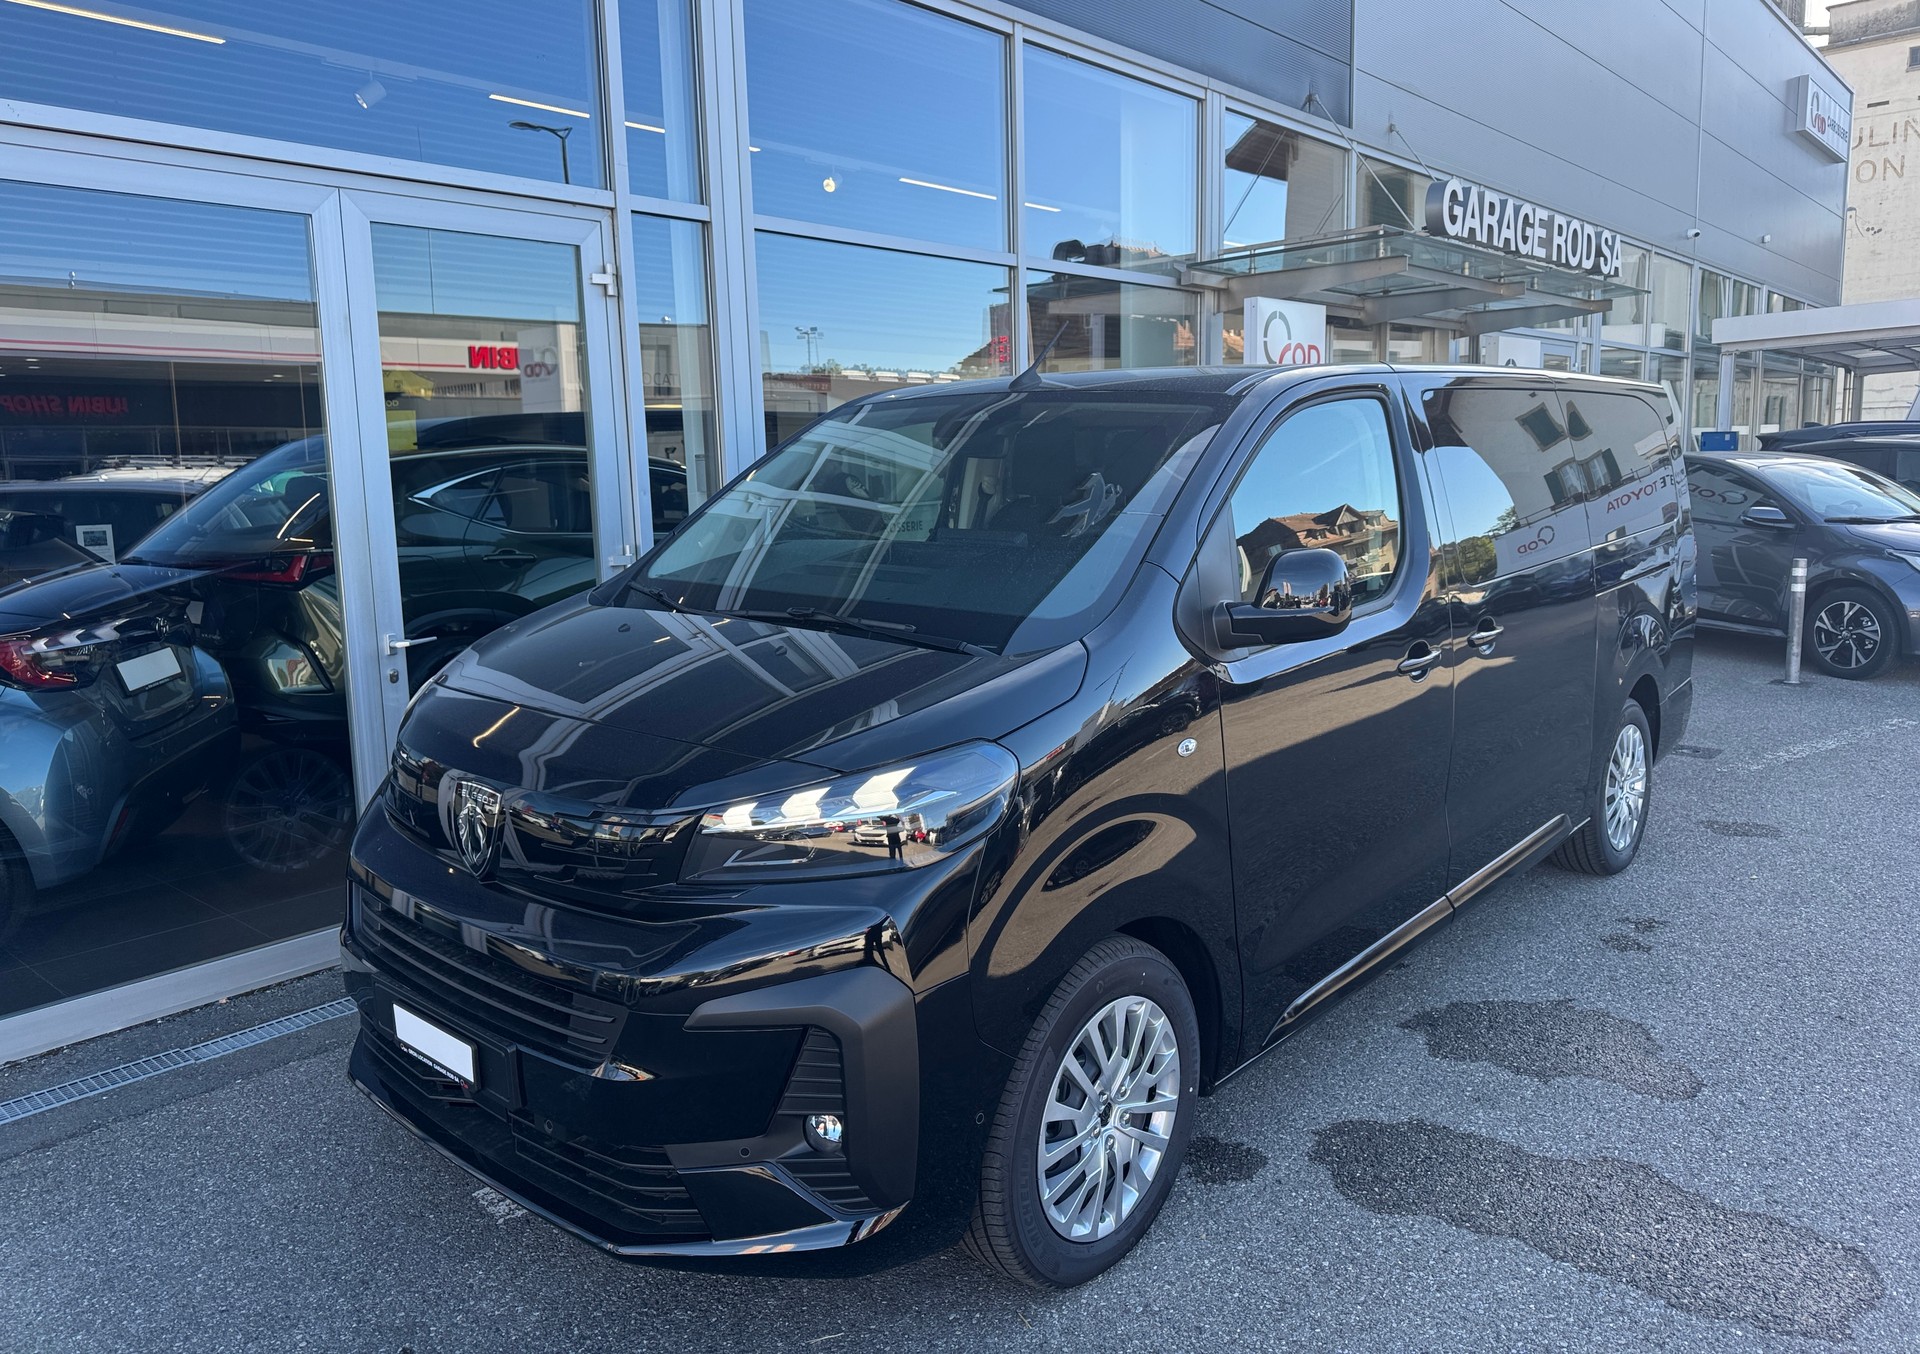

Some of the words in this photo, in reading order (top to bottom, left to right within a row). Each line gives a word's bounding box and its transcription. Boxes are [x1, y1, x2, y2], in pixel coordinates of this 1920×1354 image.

[1442, 178, 1549, 259] GARAGE
[1552, 214, 1596, 270] ROD
[1599, 229, 1623, 278] SA
